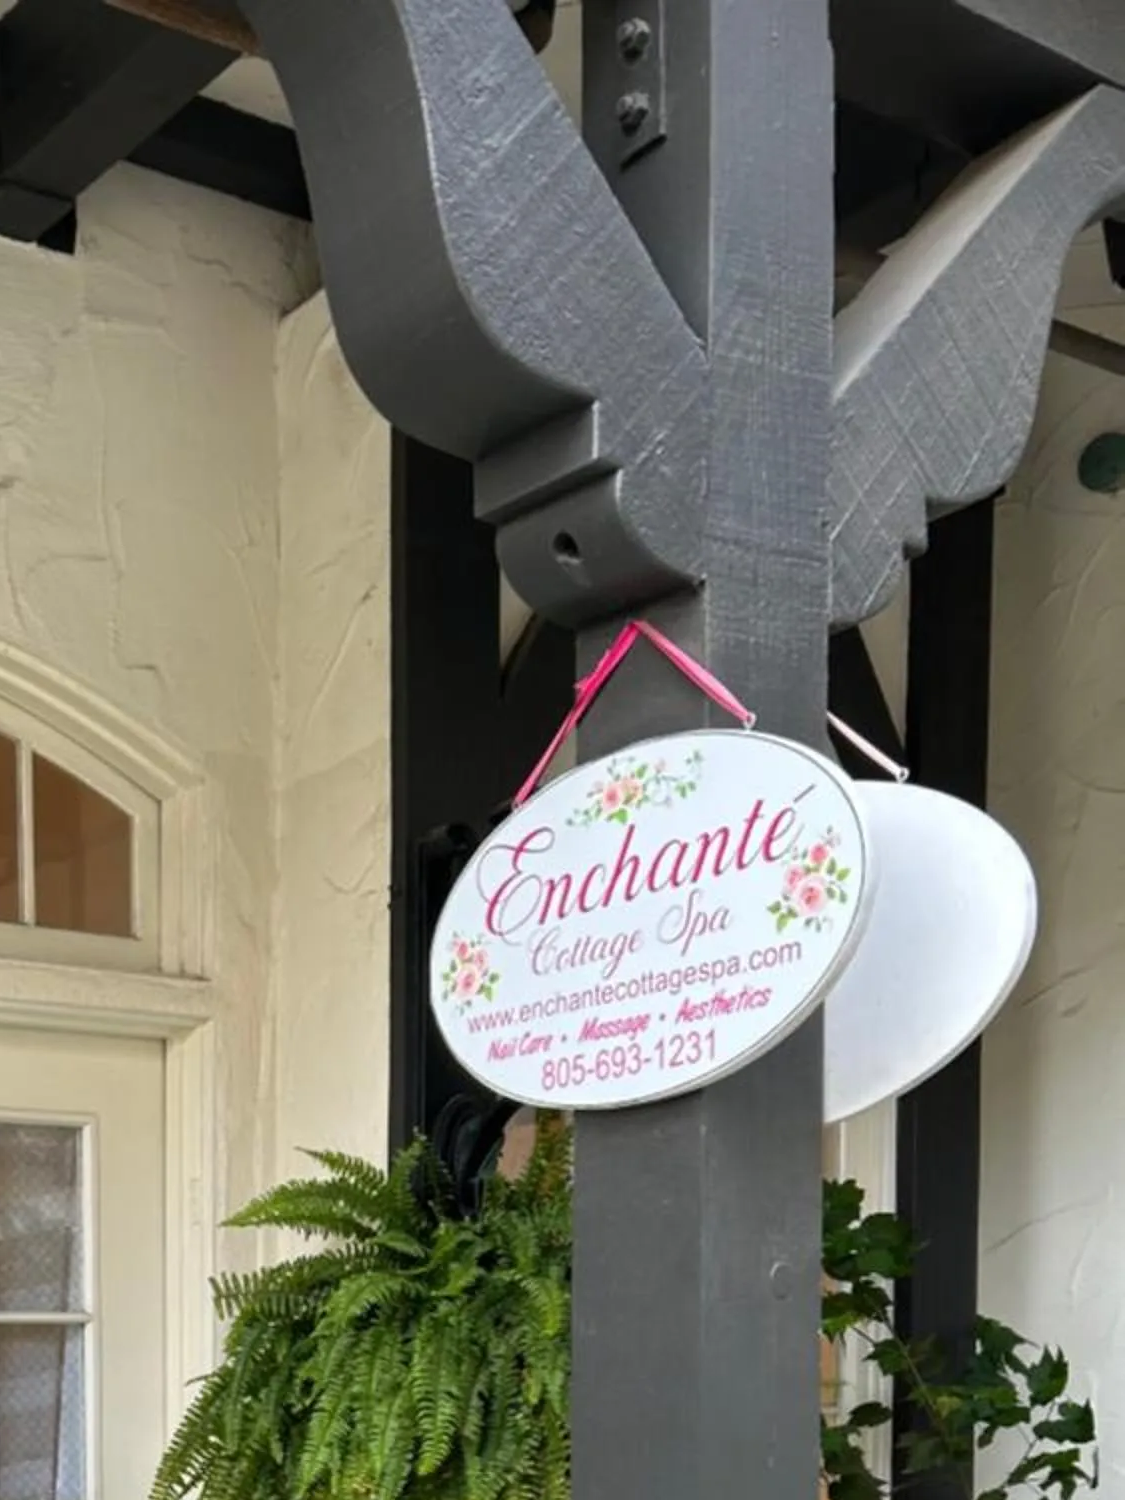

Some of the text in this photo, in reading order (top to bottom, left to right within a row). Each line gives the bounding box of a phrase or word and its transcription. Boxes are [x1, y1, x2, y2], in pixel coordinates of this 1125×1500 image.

[477, 784, 815, 947] Enchanté
[528, 888, 733, 980] Cottage Spa
[467, 941, 802, 1034] www.enchantecottagespa.com
[578, 1013, 652, 1042] Massage
[675, 986, 773, 1024] Aesthetics
[542, 1028, 716, 1091] 805-693-1231
